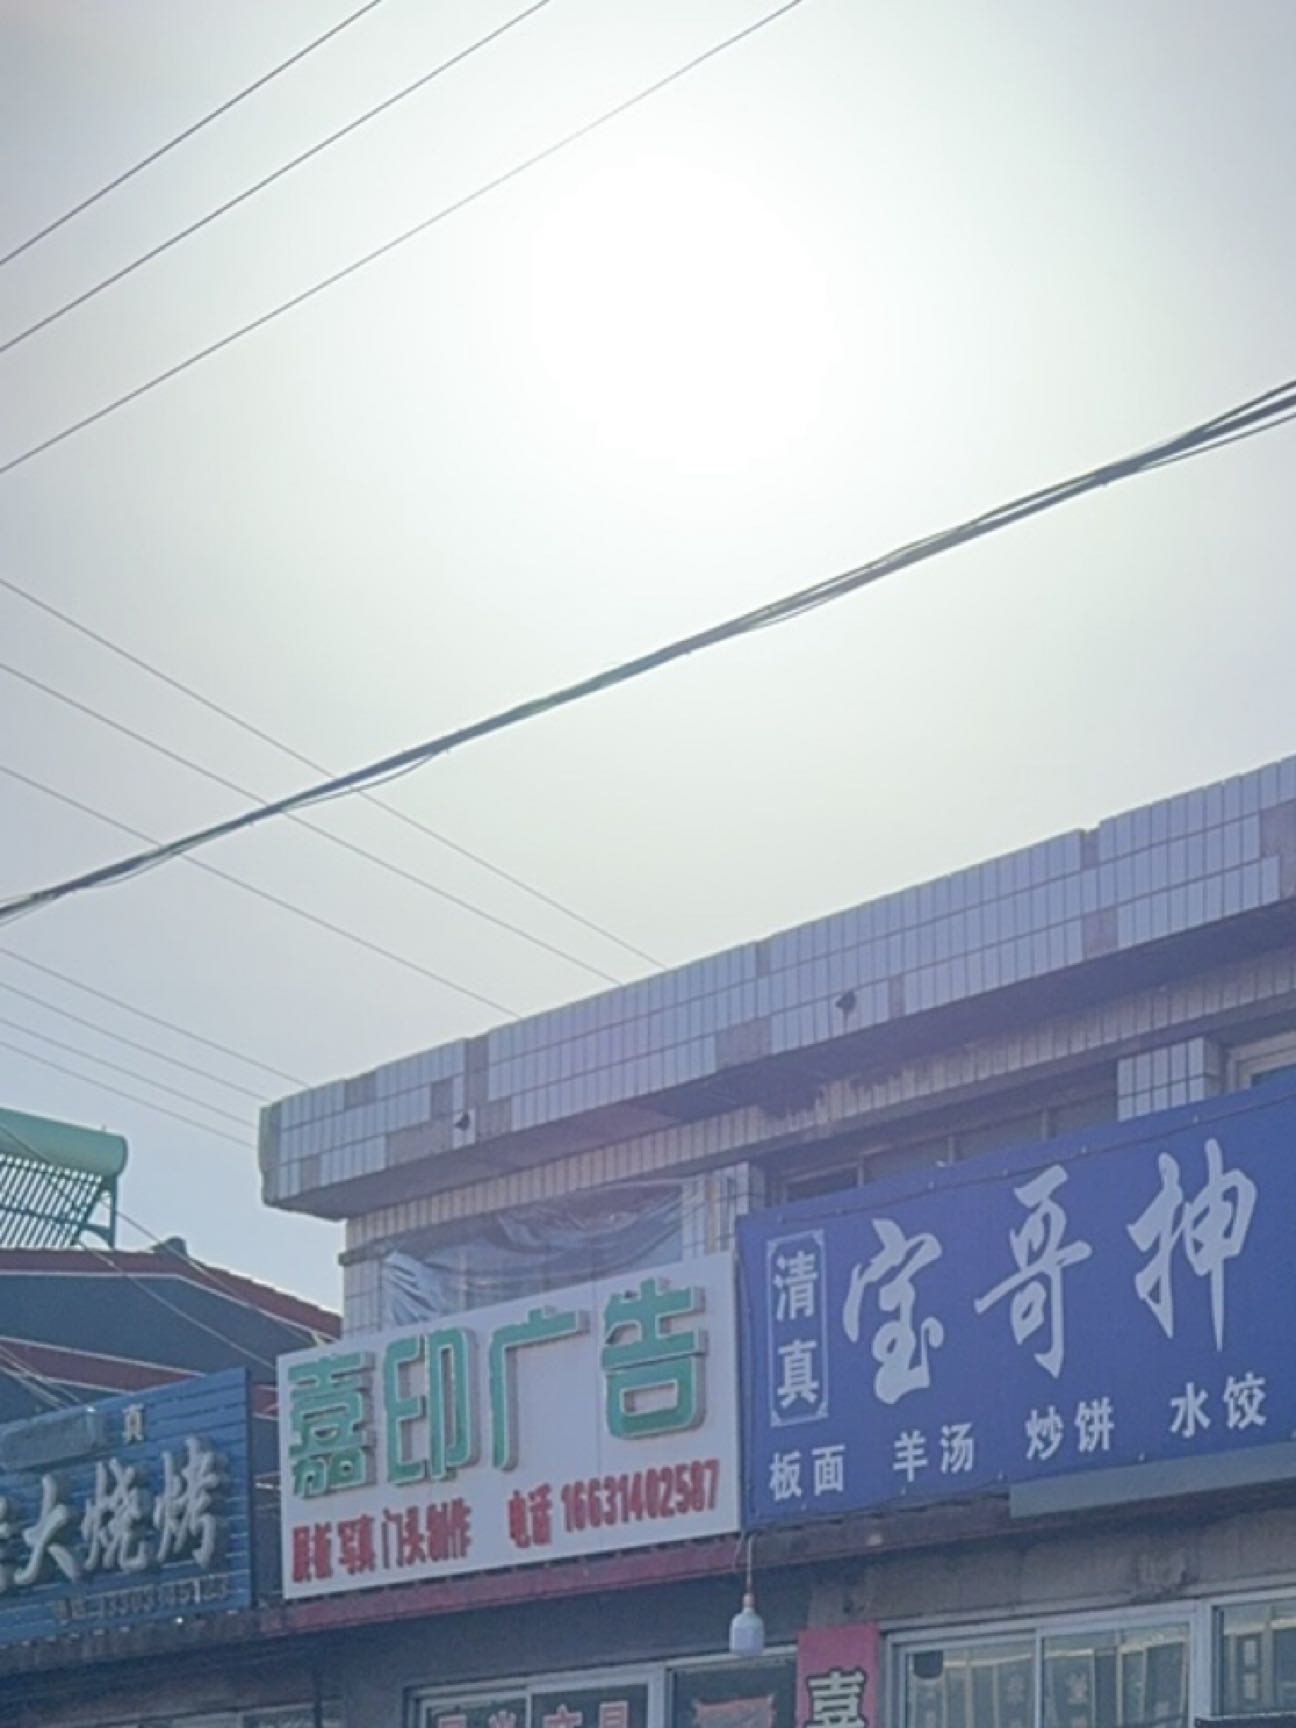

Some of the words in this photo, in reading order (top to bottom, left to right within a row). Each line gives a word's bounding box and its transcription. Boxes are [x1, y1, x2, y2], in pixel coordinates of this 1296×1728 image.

[287, 1277, 706, 1500] 嘉印广告
[771, 1250, 819, 1407] 清真
[769, 1445, 846, 1500] 板面
[892, 1425, 975, 1481] 羊汤
[1025, 1399, 1115, 1460] 炒饼
[1169, 1372, 1267, 1437] 水饺
[0, 1437, 220, 1590] 大烧烤
[508, 1483, 552, 1549] 电话
